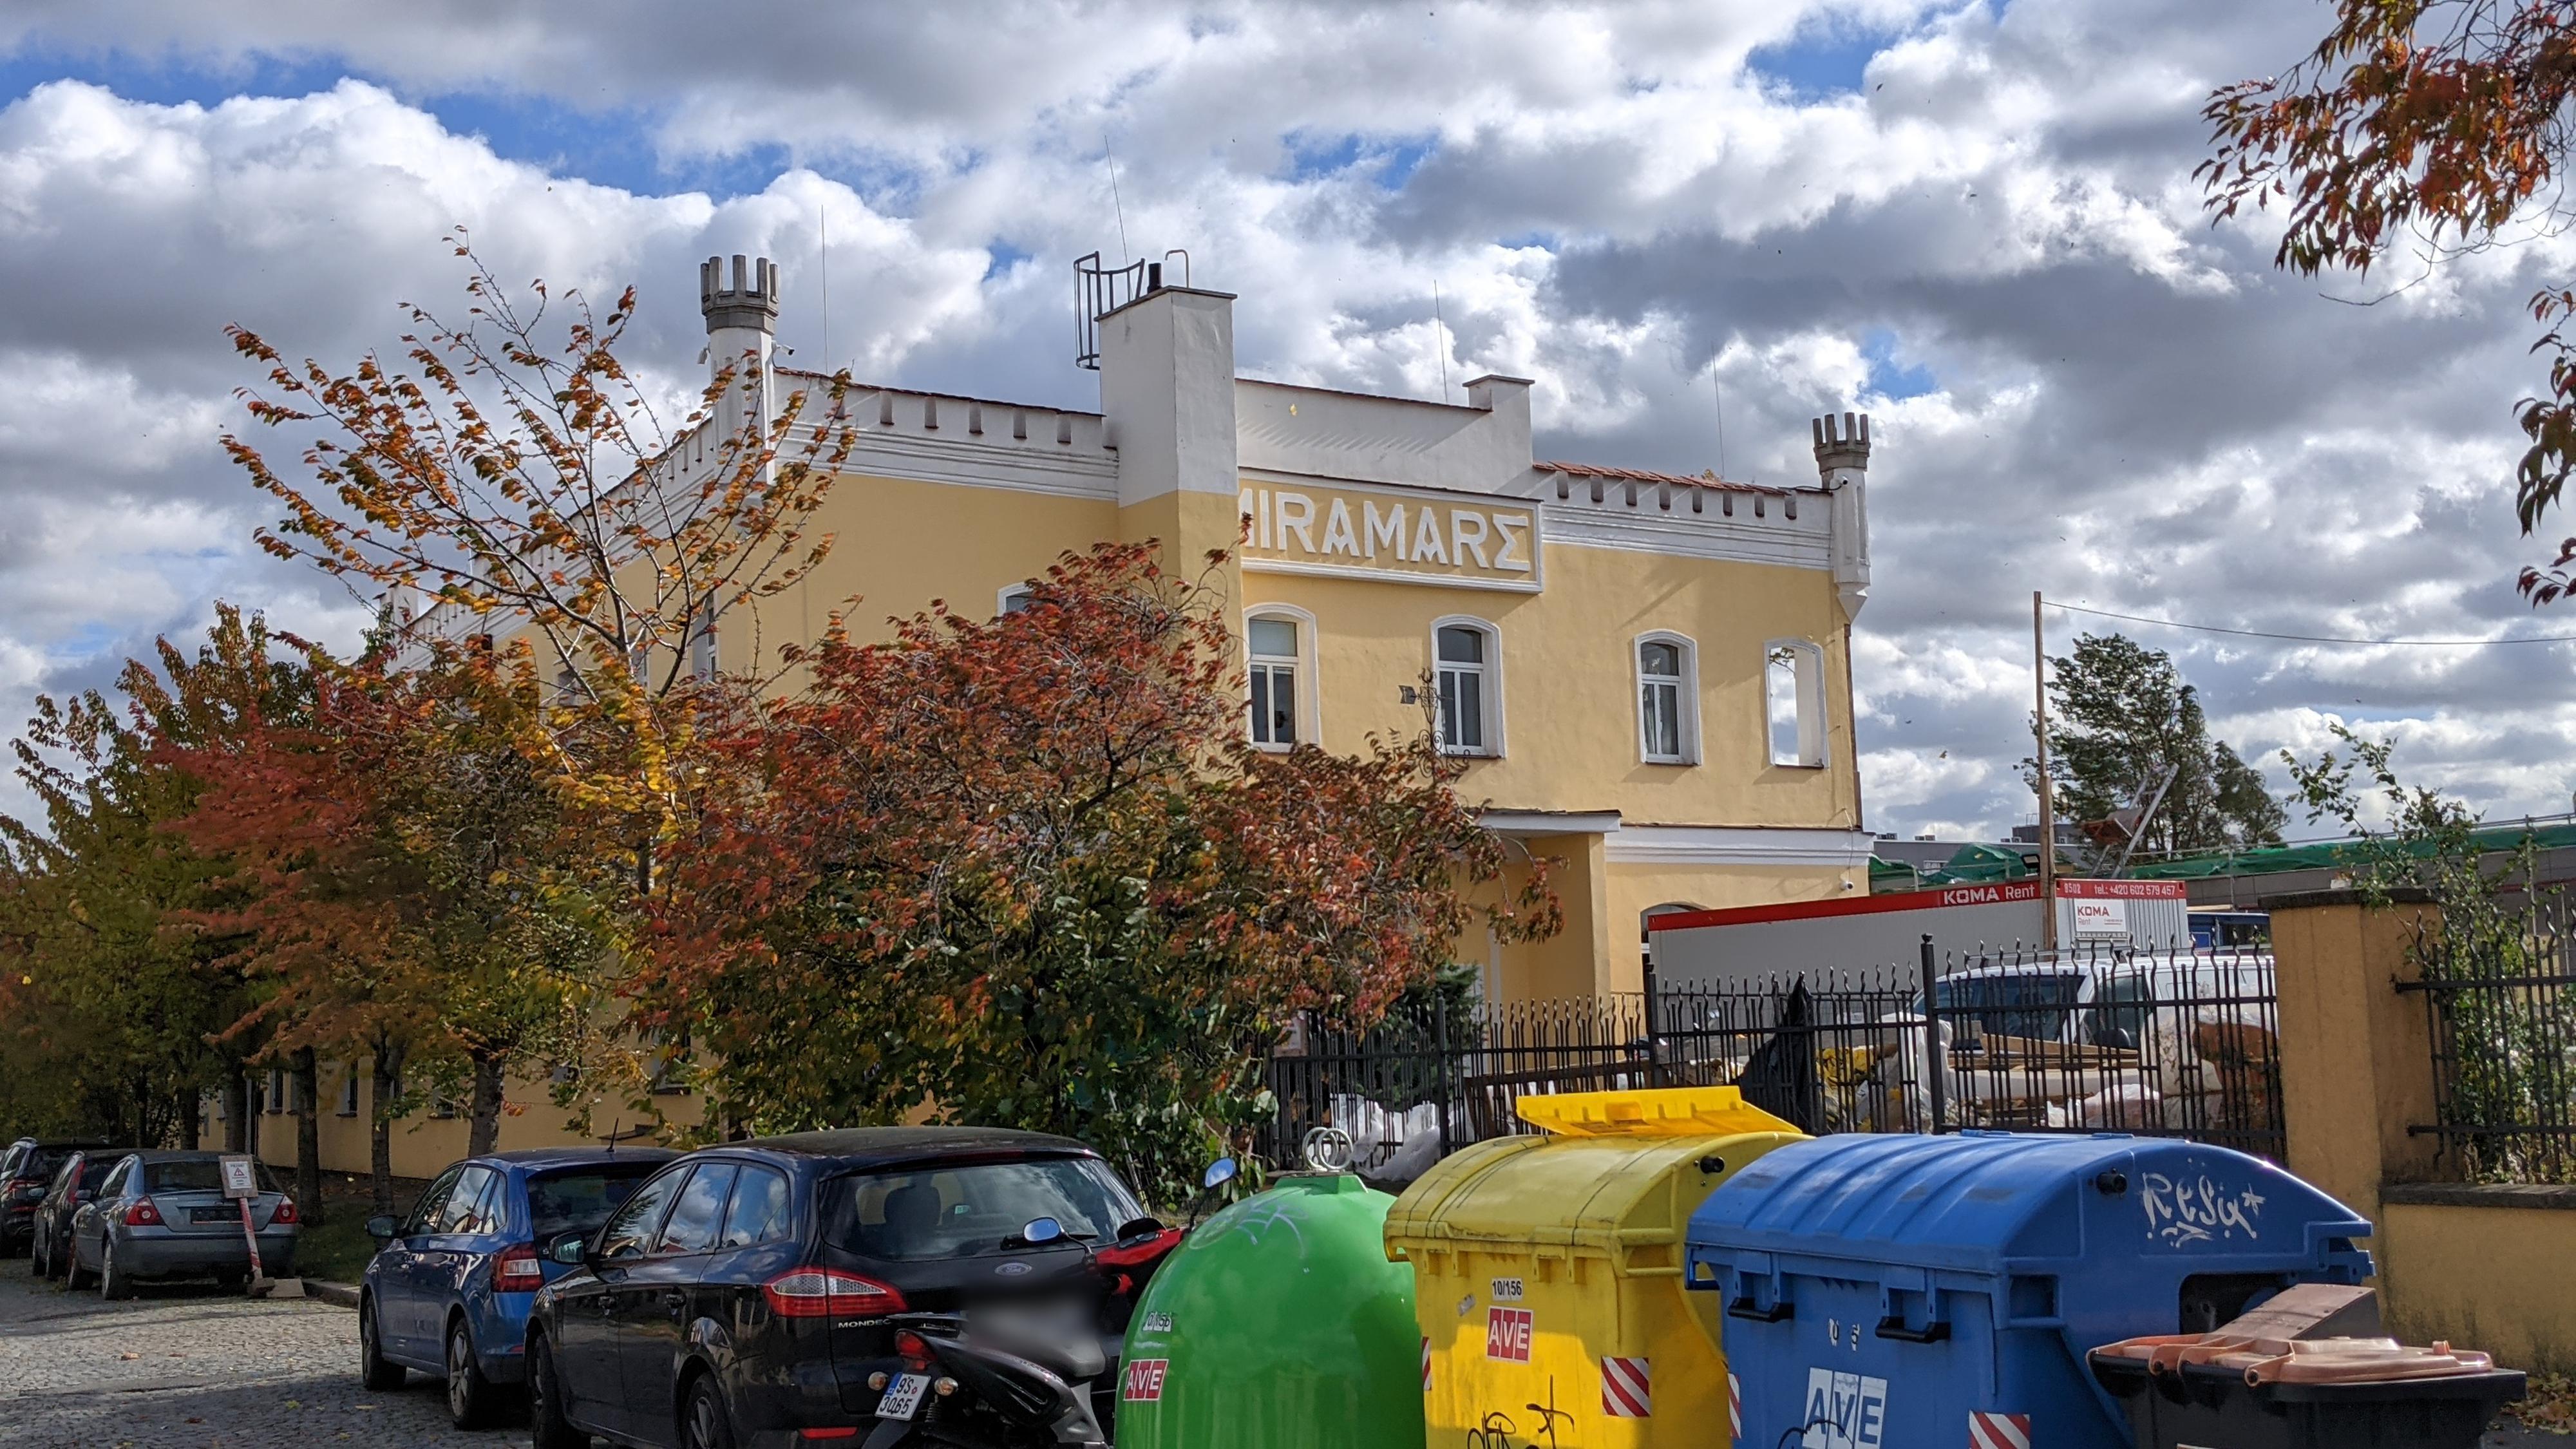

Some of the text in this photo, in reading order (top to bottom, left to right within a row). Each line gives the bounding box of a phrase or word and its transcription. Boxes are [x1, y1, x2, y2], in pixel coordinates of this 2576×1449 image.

[1944, 884, 2035, 904] KOMA Rent
[2110, 885, 2128, 895] +420
[2130, 885, 2144, 895] 602
[2146, 885, 2160, 895] 579
[2161, 885, 2175, 896] 457
[2078, 906, 2110, 916] KOMA
[1492, 1280, 1522, 1296] 10/156
[1488, 1320, 1530, 1350] AVE
[896, 1377, 914, 1394] 9S
[1126, 1370, 1162, 1390] AVE
[879, 1396, 913, 1415] 3065
[1806, 1387, 1882, 1444] AVE
